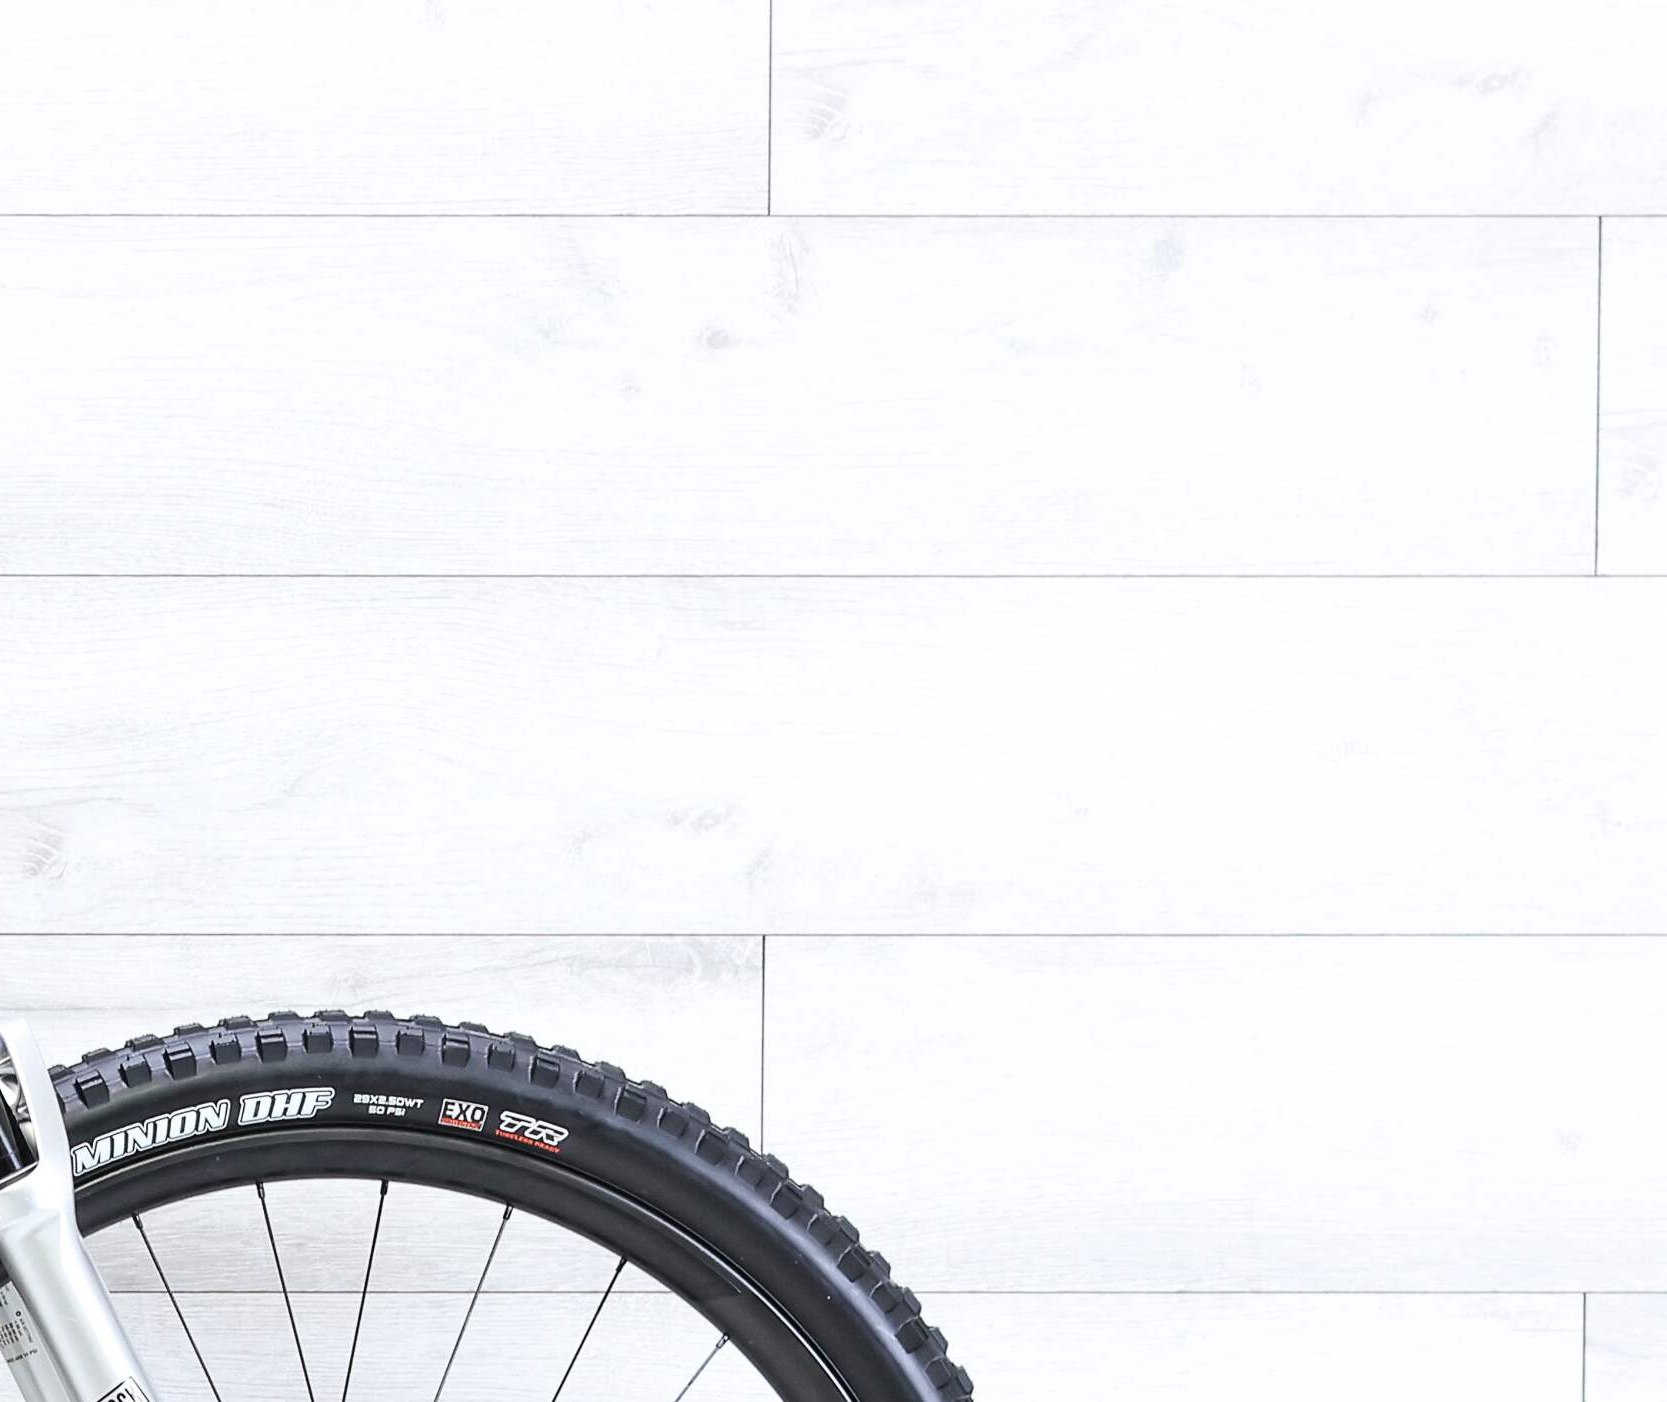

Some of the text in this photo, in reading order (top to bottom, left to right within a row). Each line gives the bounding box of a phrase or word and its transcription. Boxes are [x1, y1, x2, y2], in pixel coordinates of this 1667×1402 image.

[386, 1107, 406, 1117] PSI
[442, 1100, 486, 1123] EXO
[72, 1087, 335, 1176] MINION DHF
[499, 1110, 569, 1147] TR
